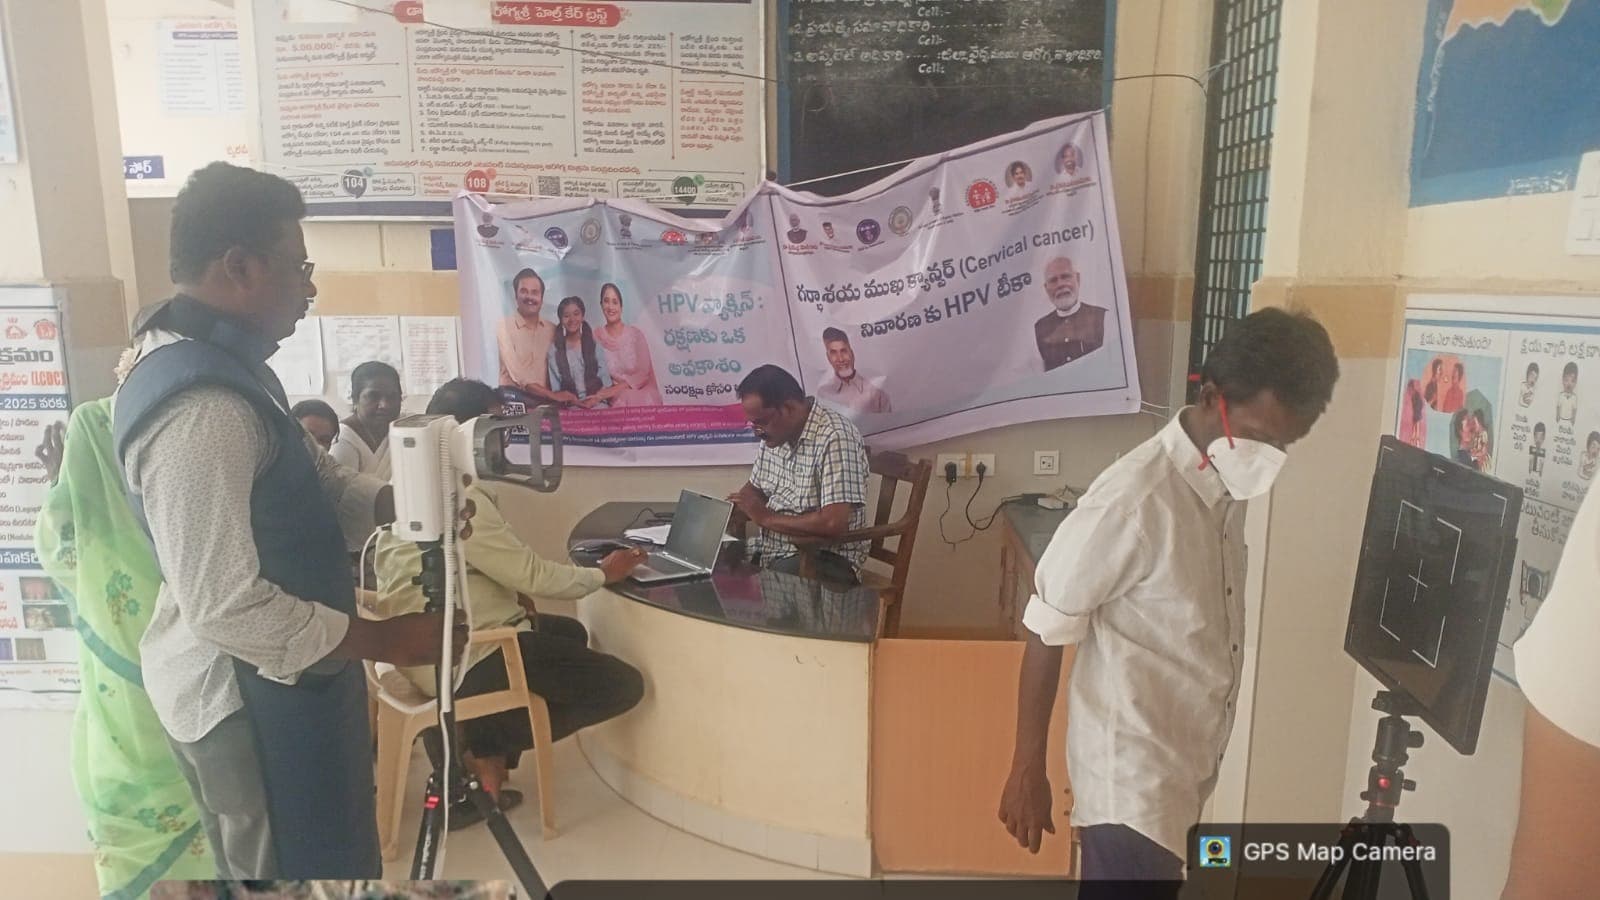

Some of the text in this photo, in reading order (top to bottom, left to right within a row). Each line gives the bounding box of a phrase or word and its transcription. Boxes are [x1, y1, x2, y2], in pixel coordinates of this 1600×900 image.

[493, 5, 531, 21] రోగ్యశ్రీ
[344, 177, 363, 188] 104
[467, 178, 487, 189] 108
[959, 235, 1028, 280] (Cervical
[1032, 219, 1095, 249] cancer)
[657, 292, 699, 315] HPV
[860, 312, 922, 338] నివారణ
[944, 283, 992, 320] HPV
[996, 270, 1033, 300] టీకా
[720, 327, 746, 345] ఒక
[668, 356, 742, 377] అవకాశం
[705, 383, 733, 397] కోసం
